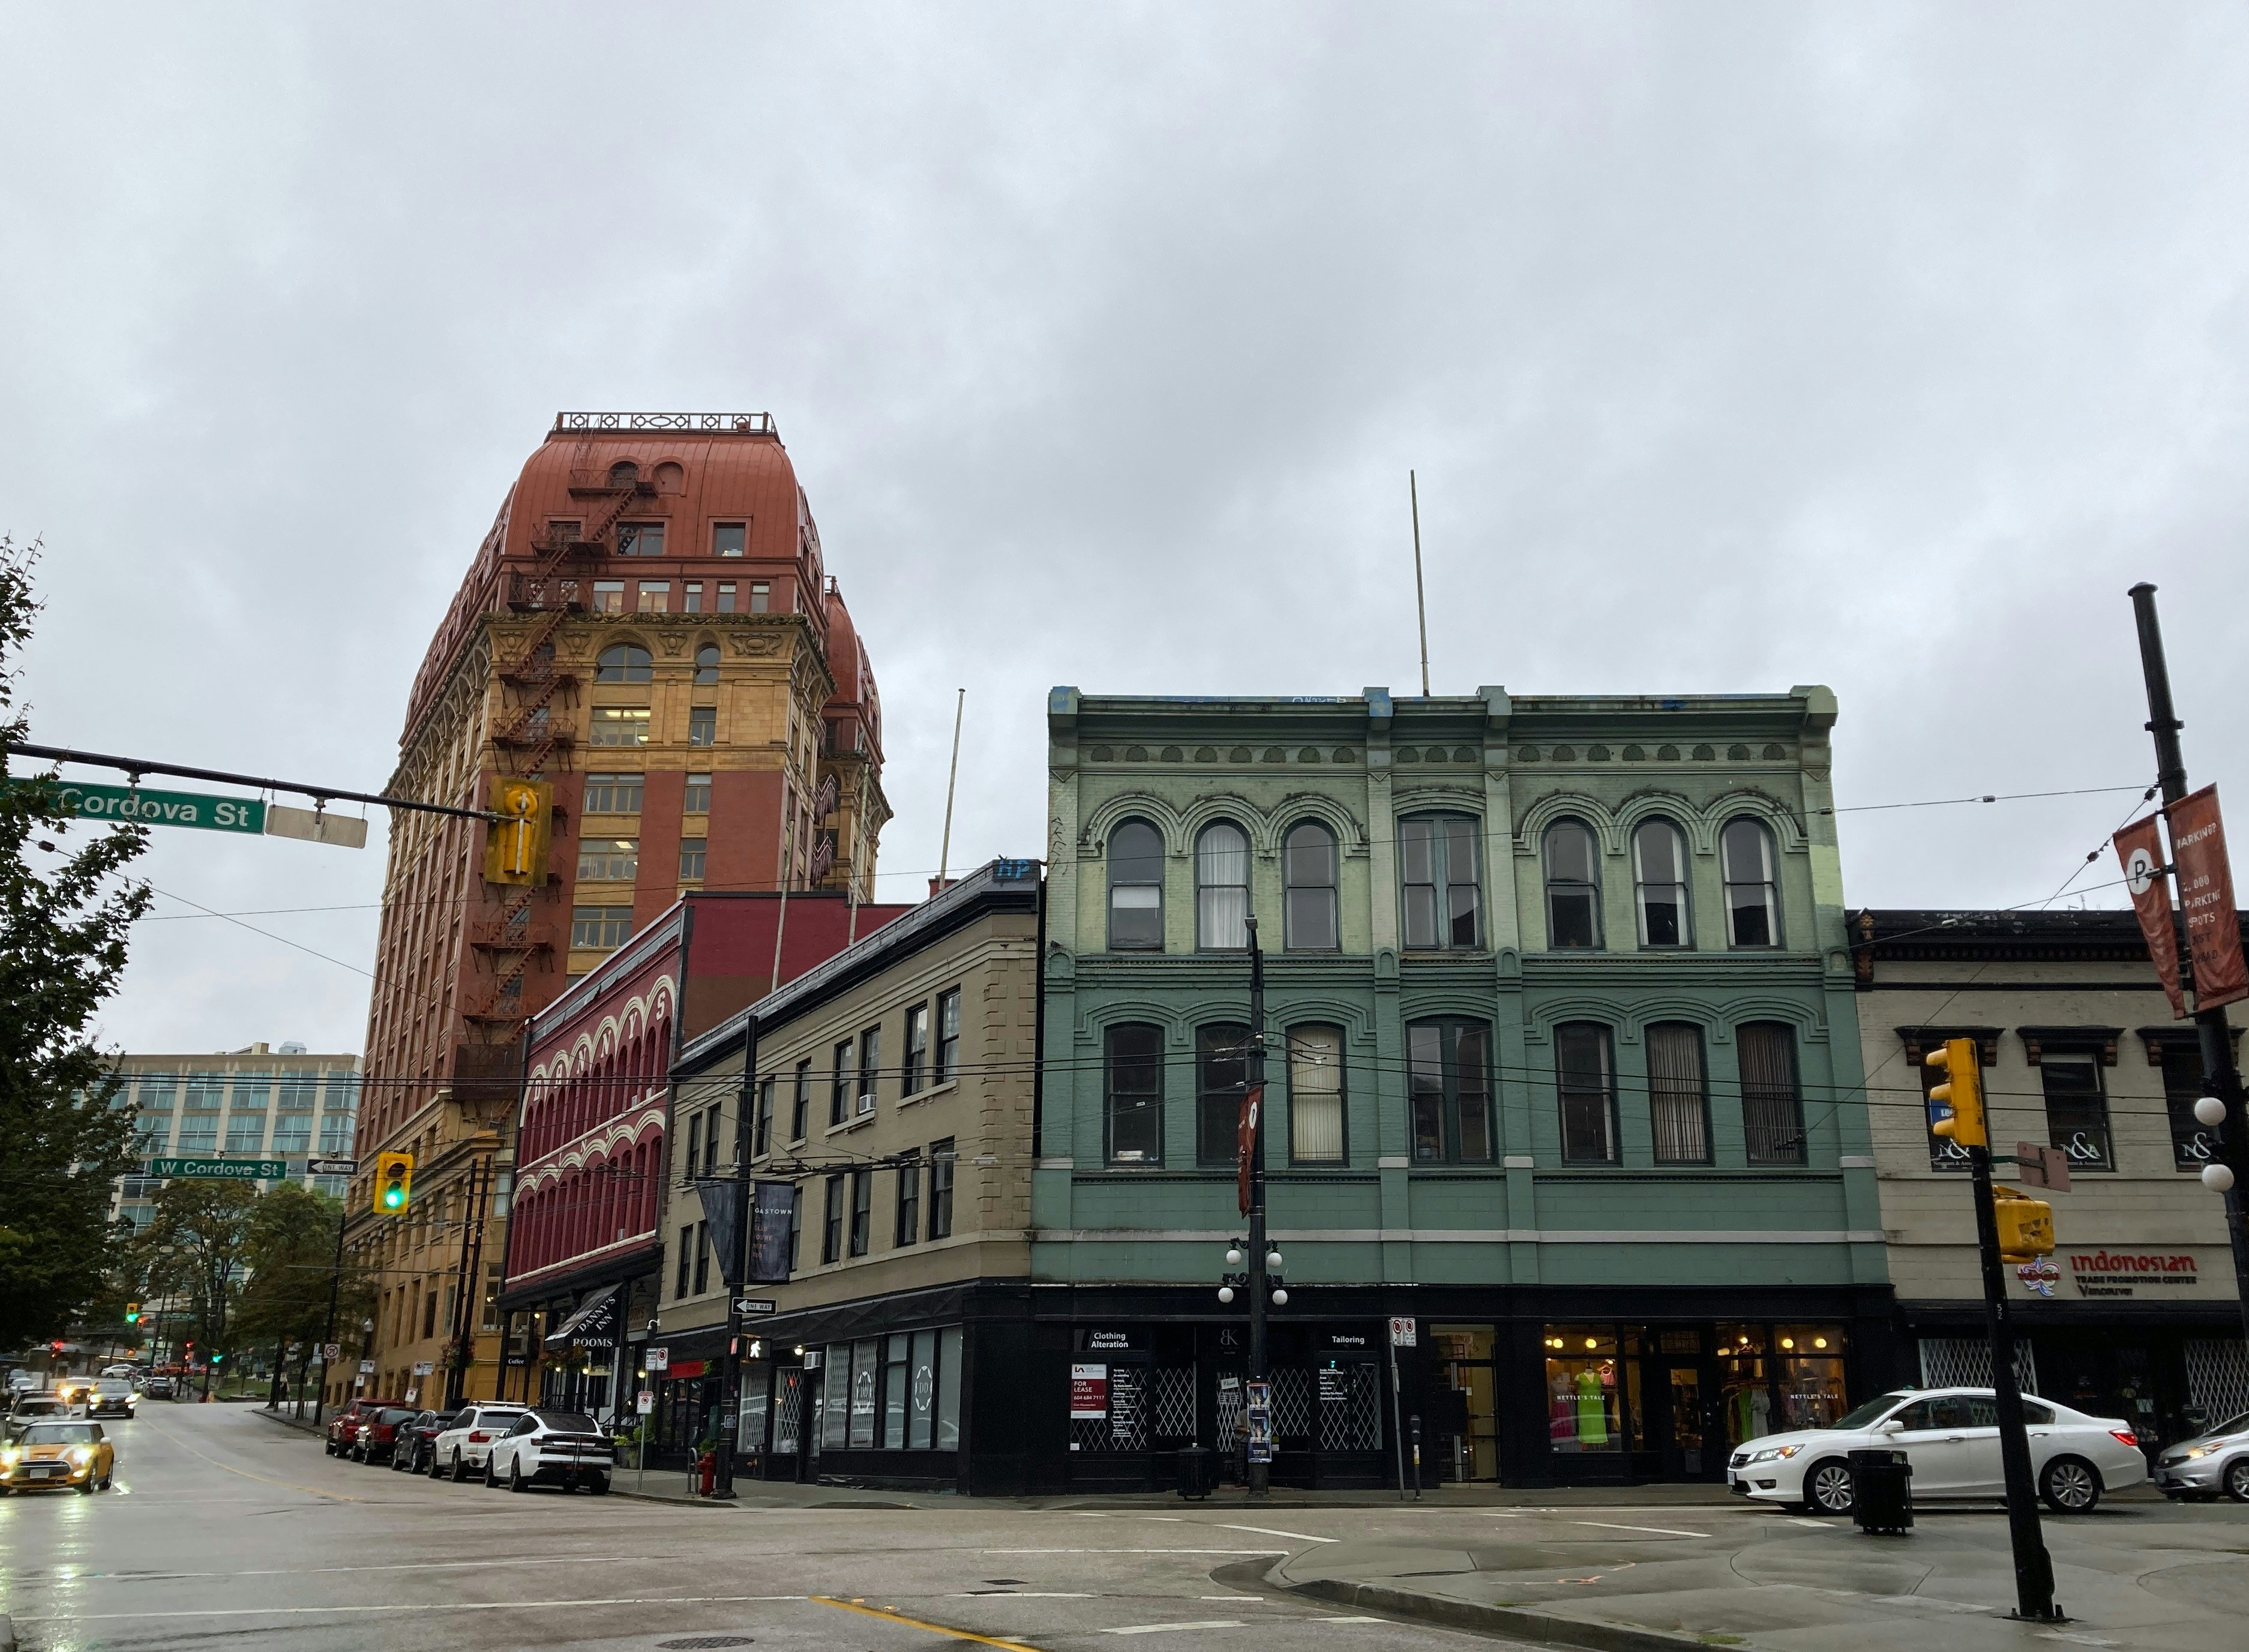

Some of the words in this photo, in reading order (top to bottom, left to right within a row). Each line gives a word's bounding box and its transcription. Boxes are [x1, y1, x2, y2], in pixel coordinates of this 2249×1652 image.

[58, 788, 197, 822] Cordova
[214, 802, 248, 827] St
[2134, 859, 2146, 885] P
[160, 1161, 177, 1174] W
[184, 1161, 252, 1176] Cordova
[260, 1163, 278, 1176] St
[2075, 1275, 2105, 1284] TRADE
[2163, 1276, 2197, 1284] CENTER
[2077, 1284, 2133, 1297] Vancouver
[578, 1296, 616, 1333] DANNY'S
[595, 1312, 613, 1331] INN
[572, 1338, 613, 1347] ROOMS
[1093, 1332, 1126, 1341] Clothing
[1332, 1336, 1365, 1344] Tailoring
